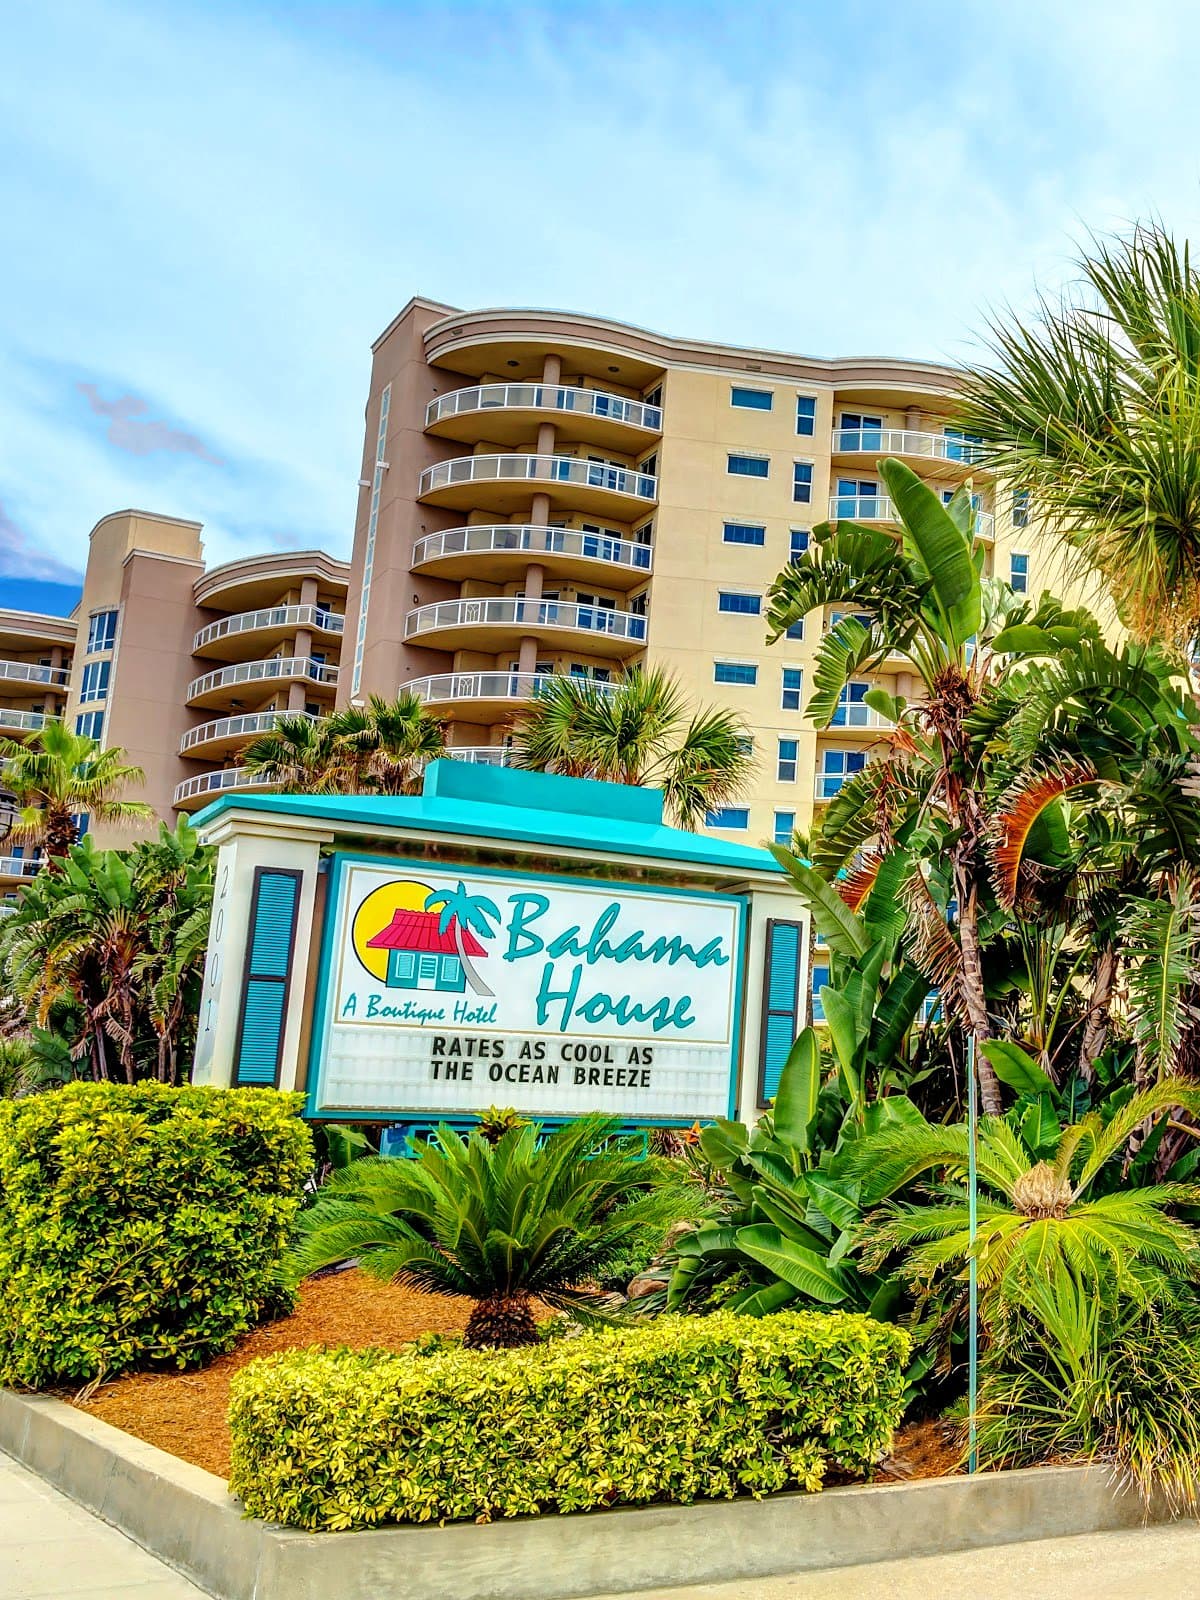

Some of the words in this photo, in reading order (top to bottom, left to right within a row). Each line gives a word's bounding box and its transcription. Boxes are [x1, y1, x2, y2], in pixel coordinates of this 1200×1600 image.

[204, 865, 229, 1032] 2001
[503, 893, 729, 968] Bahama
[342, 992, 357, 1017] A
[366, 994, 446, 1025] Boutique
[453, 1000, 498, 1024] Hotel
[536, 962, 695, 1032] House
[431, 1061, 473, 1080] THE
[488, 1063, 559, 1084] OCEAN
[573, 1067, 651, 1088] BREEZE
[432, 1036, 504, 1058] RATES
[518, 1041, 546, 1060] AS
[560, 1043, 614, 1064] COOL
[627, 1046, 653, 1065] AS
